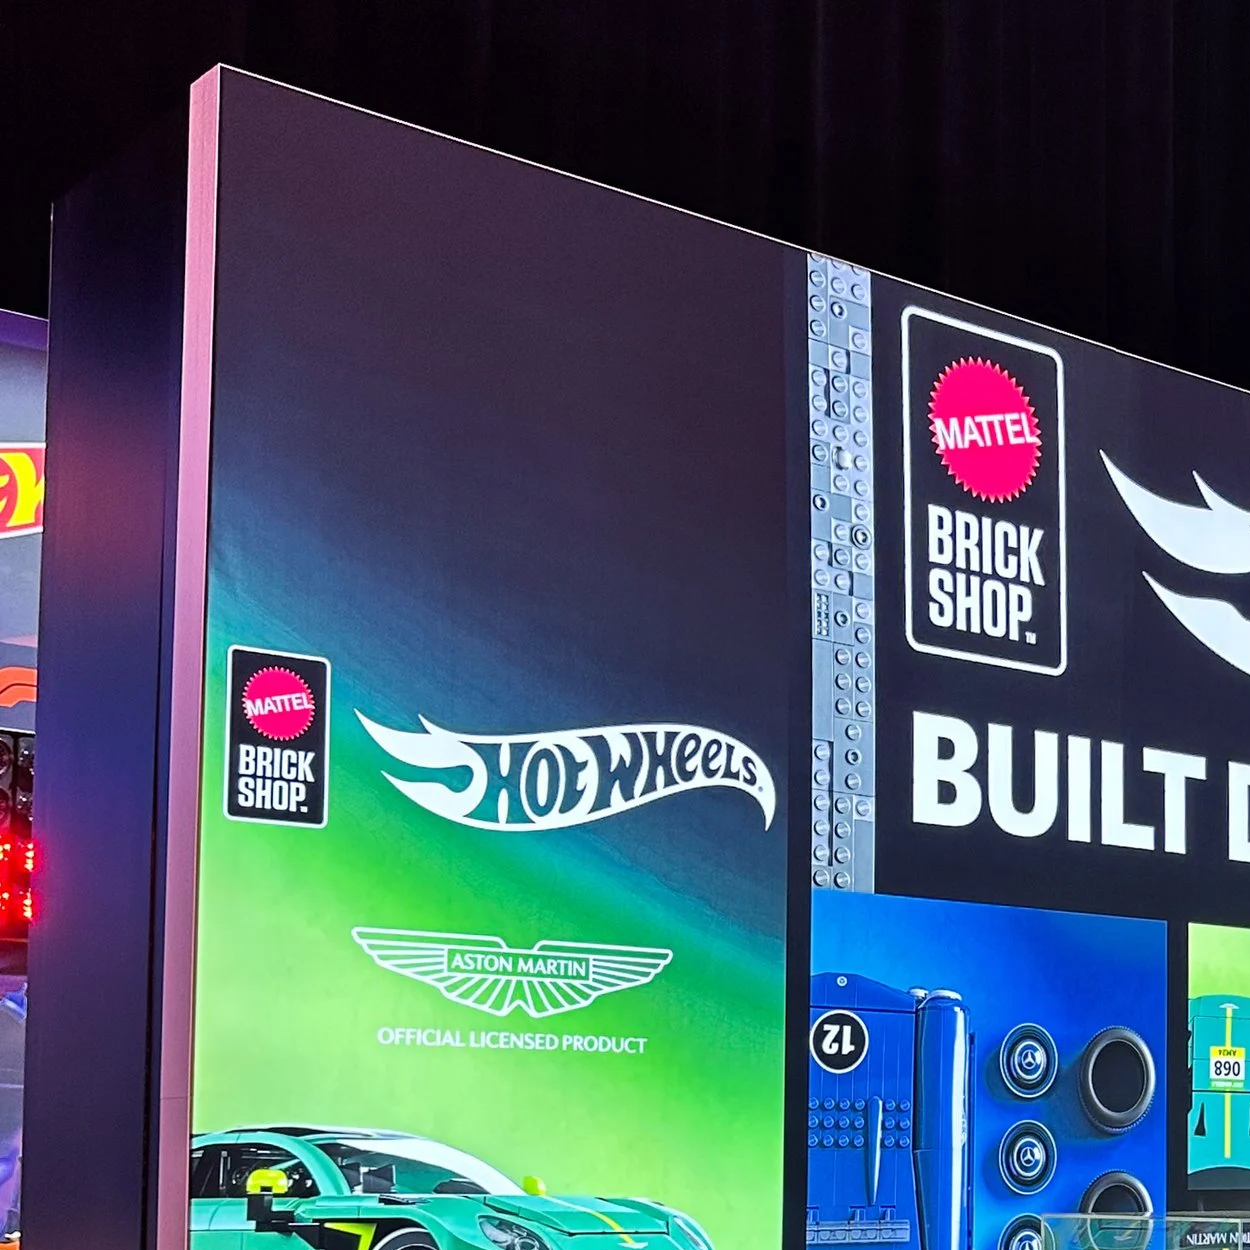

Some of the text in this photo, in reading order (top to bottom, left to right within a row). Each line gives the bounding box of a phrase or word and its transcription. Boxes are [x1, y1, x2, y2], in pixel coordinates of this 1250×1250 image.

[934, 412, 1038, 451] MATTEL
[927, 503, 1046, 586] BRICK
[244, 692, 314, 718] MATTEL
[237, 743, 316, 783] BRICK
[912, 710, 1208, 855] BUILT
[451, 953, 587, 977] ASTON MARTIN
[377, 1026, 649, 1054] OFFICIAL LICENSED PRODUCT
[821, 1023, 856, 1056] 12
[1185, 1231, 1227, 1246] MARTIN
